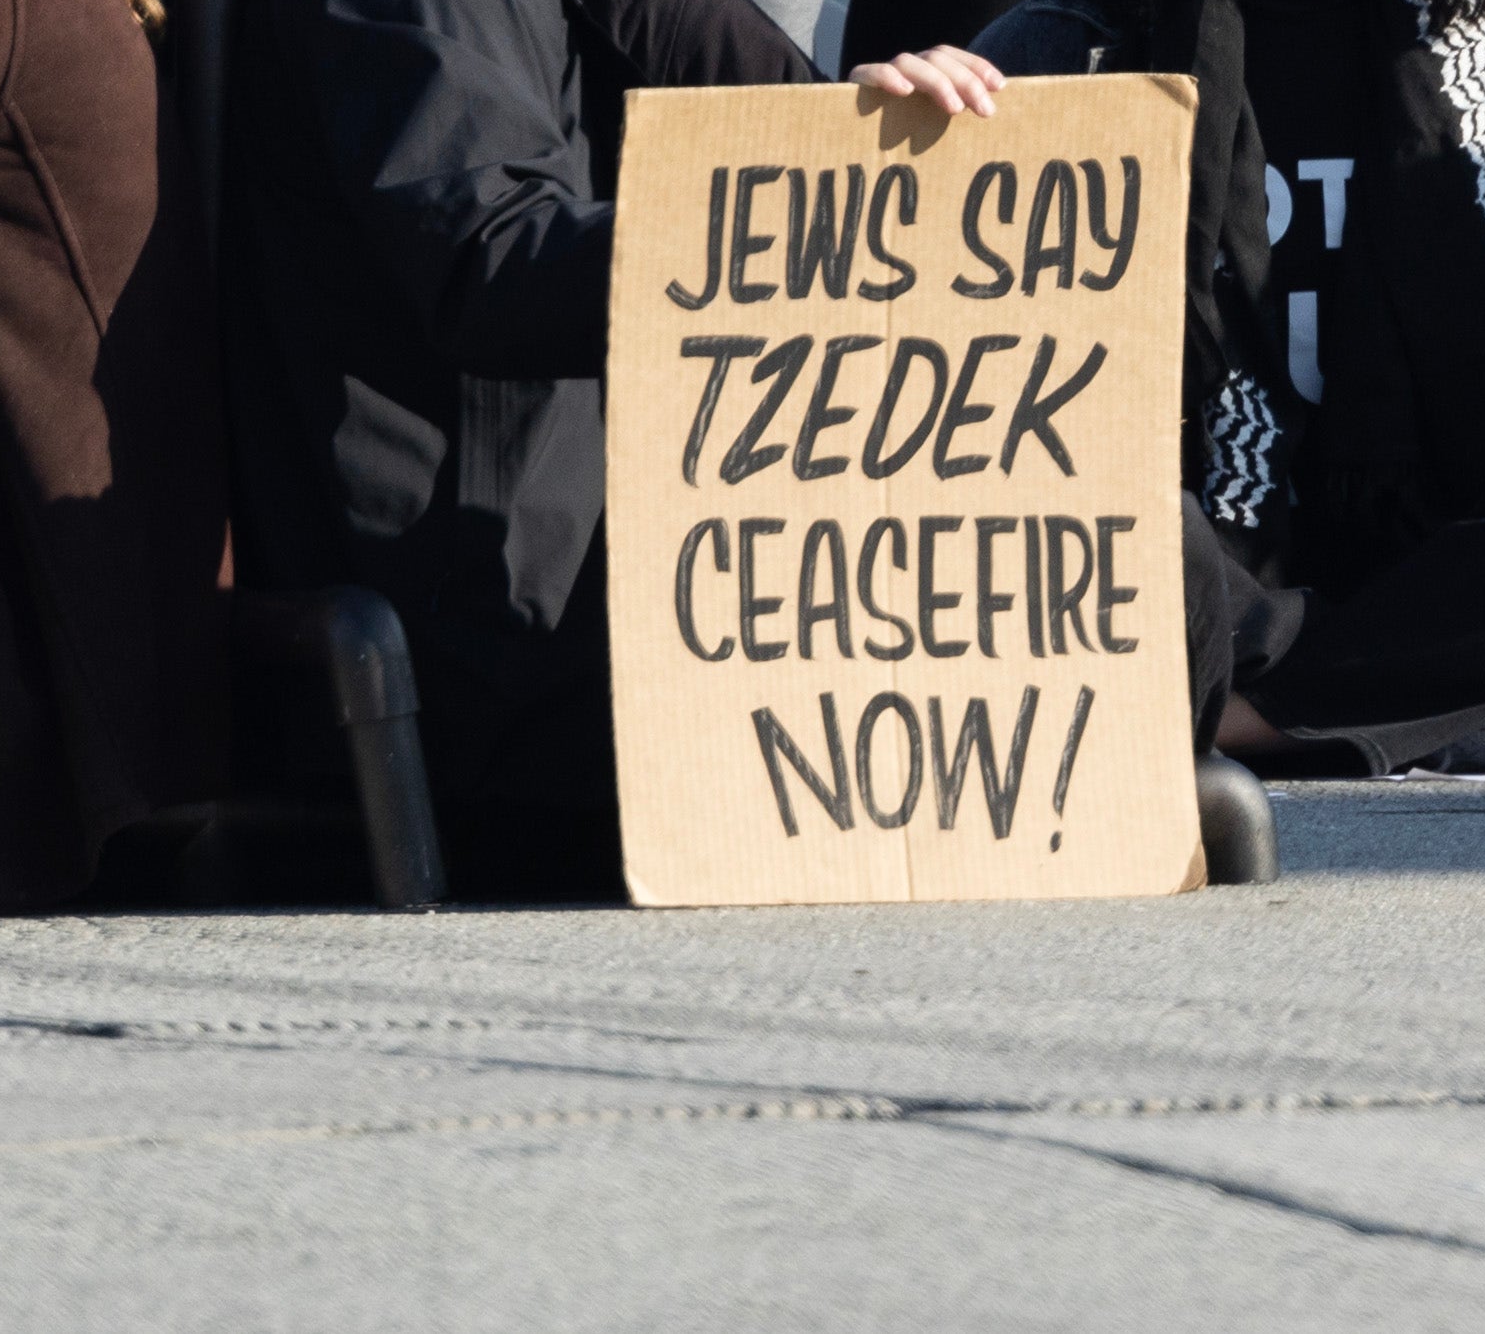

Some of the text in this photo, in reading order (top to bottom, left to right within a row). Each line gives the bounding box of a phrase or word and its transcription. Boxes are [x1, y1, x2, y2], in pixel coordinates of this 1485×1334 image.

[666, 162, 918, 311] JEWS
[950, 155, 1141, 300] SAY
[680, 333, 1108, 489] TZEDEK
[675, 516, 1138, 664] CEASEFIRE
[751, 684, 1096, 854] NOW!
